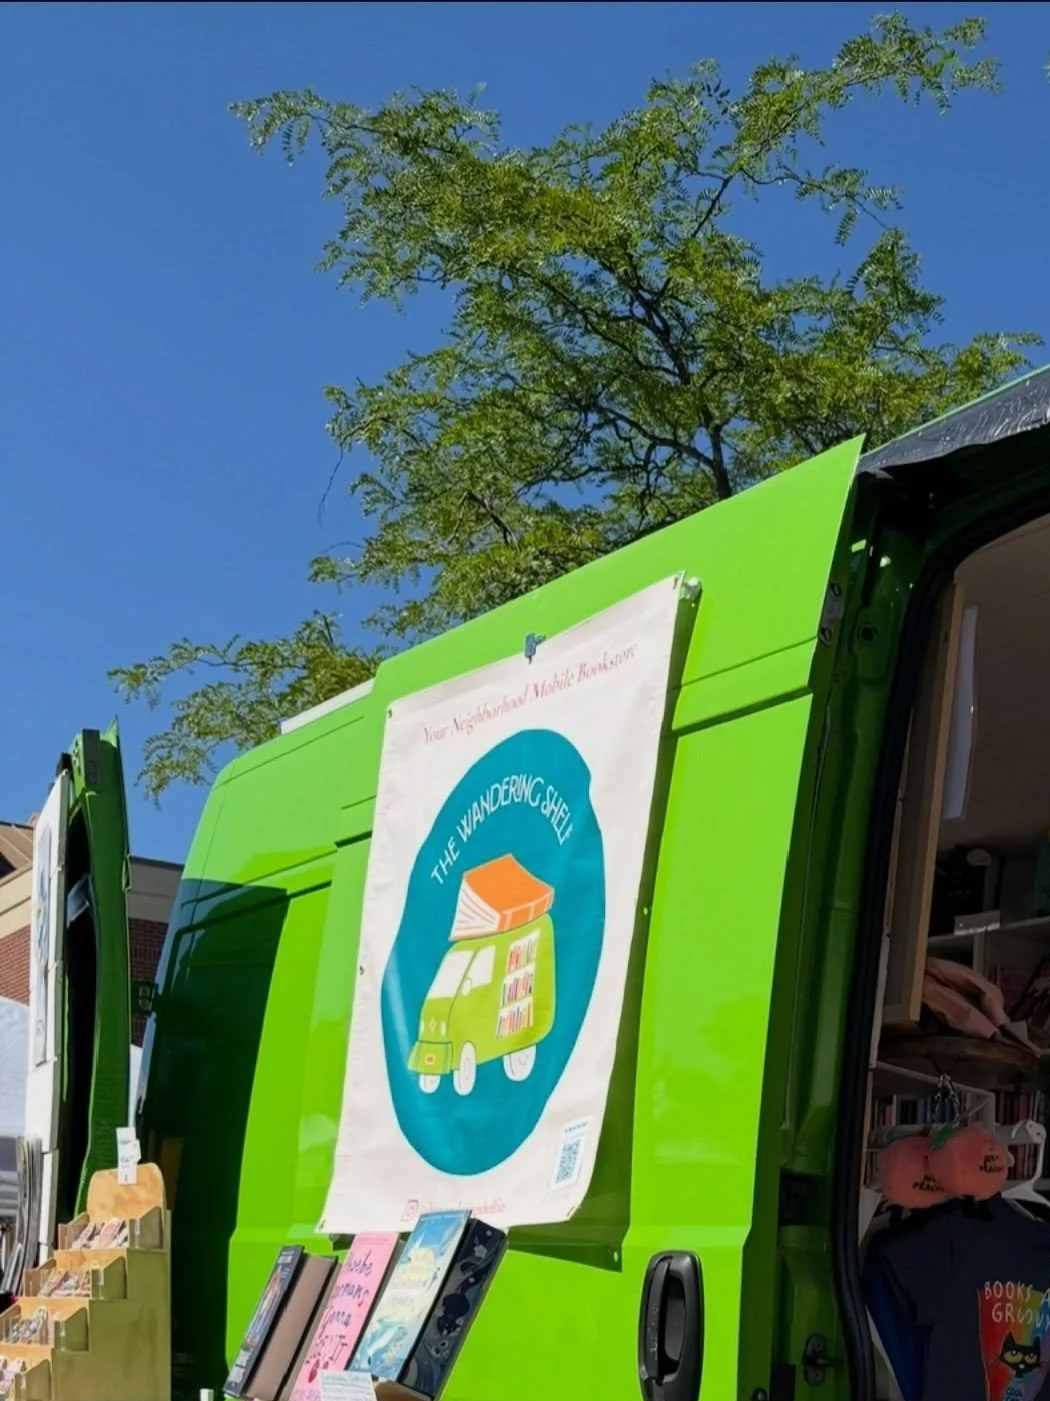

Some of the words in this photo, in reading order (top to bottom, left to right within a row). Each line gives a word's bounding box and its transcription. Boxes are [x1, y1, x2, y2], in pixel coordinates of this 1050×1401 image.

[424, 725, 449, 744] Your
[452, 682, 530, 736] Neighborhood
[533, 667, 575, 700] Mobile
[578, 643, 639, 684] Bookstore
[430, 835, 460, 885] THE
[456, 773, 545, 843] WANDERING
[540, 784, 573, 847] SHELF
[984, 1280, 1034, 1300] BOOKS
